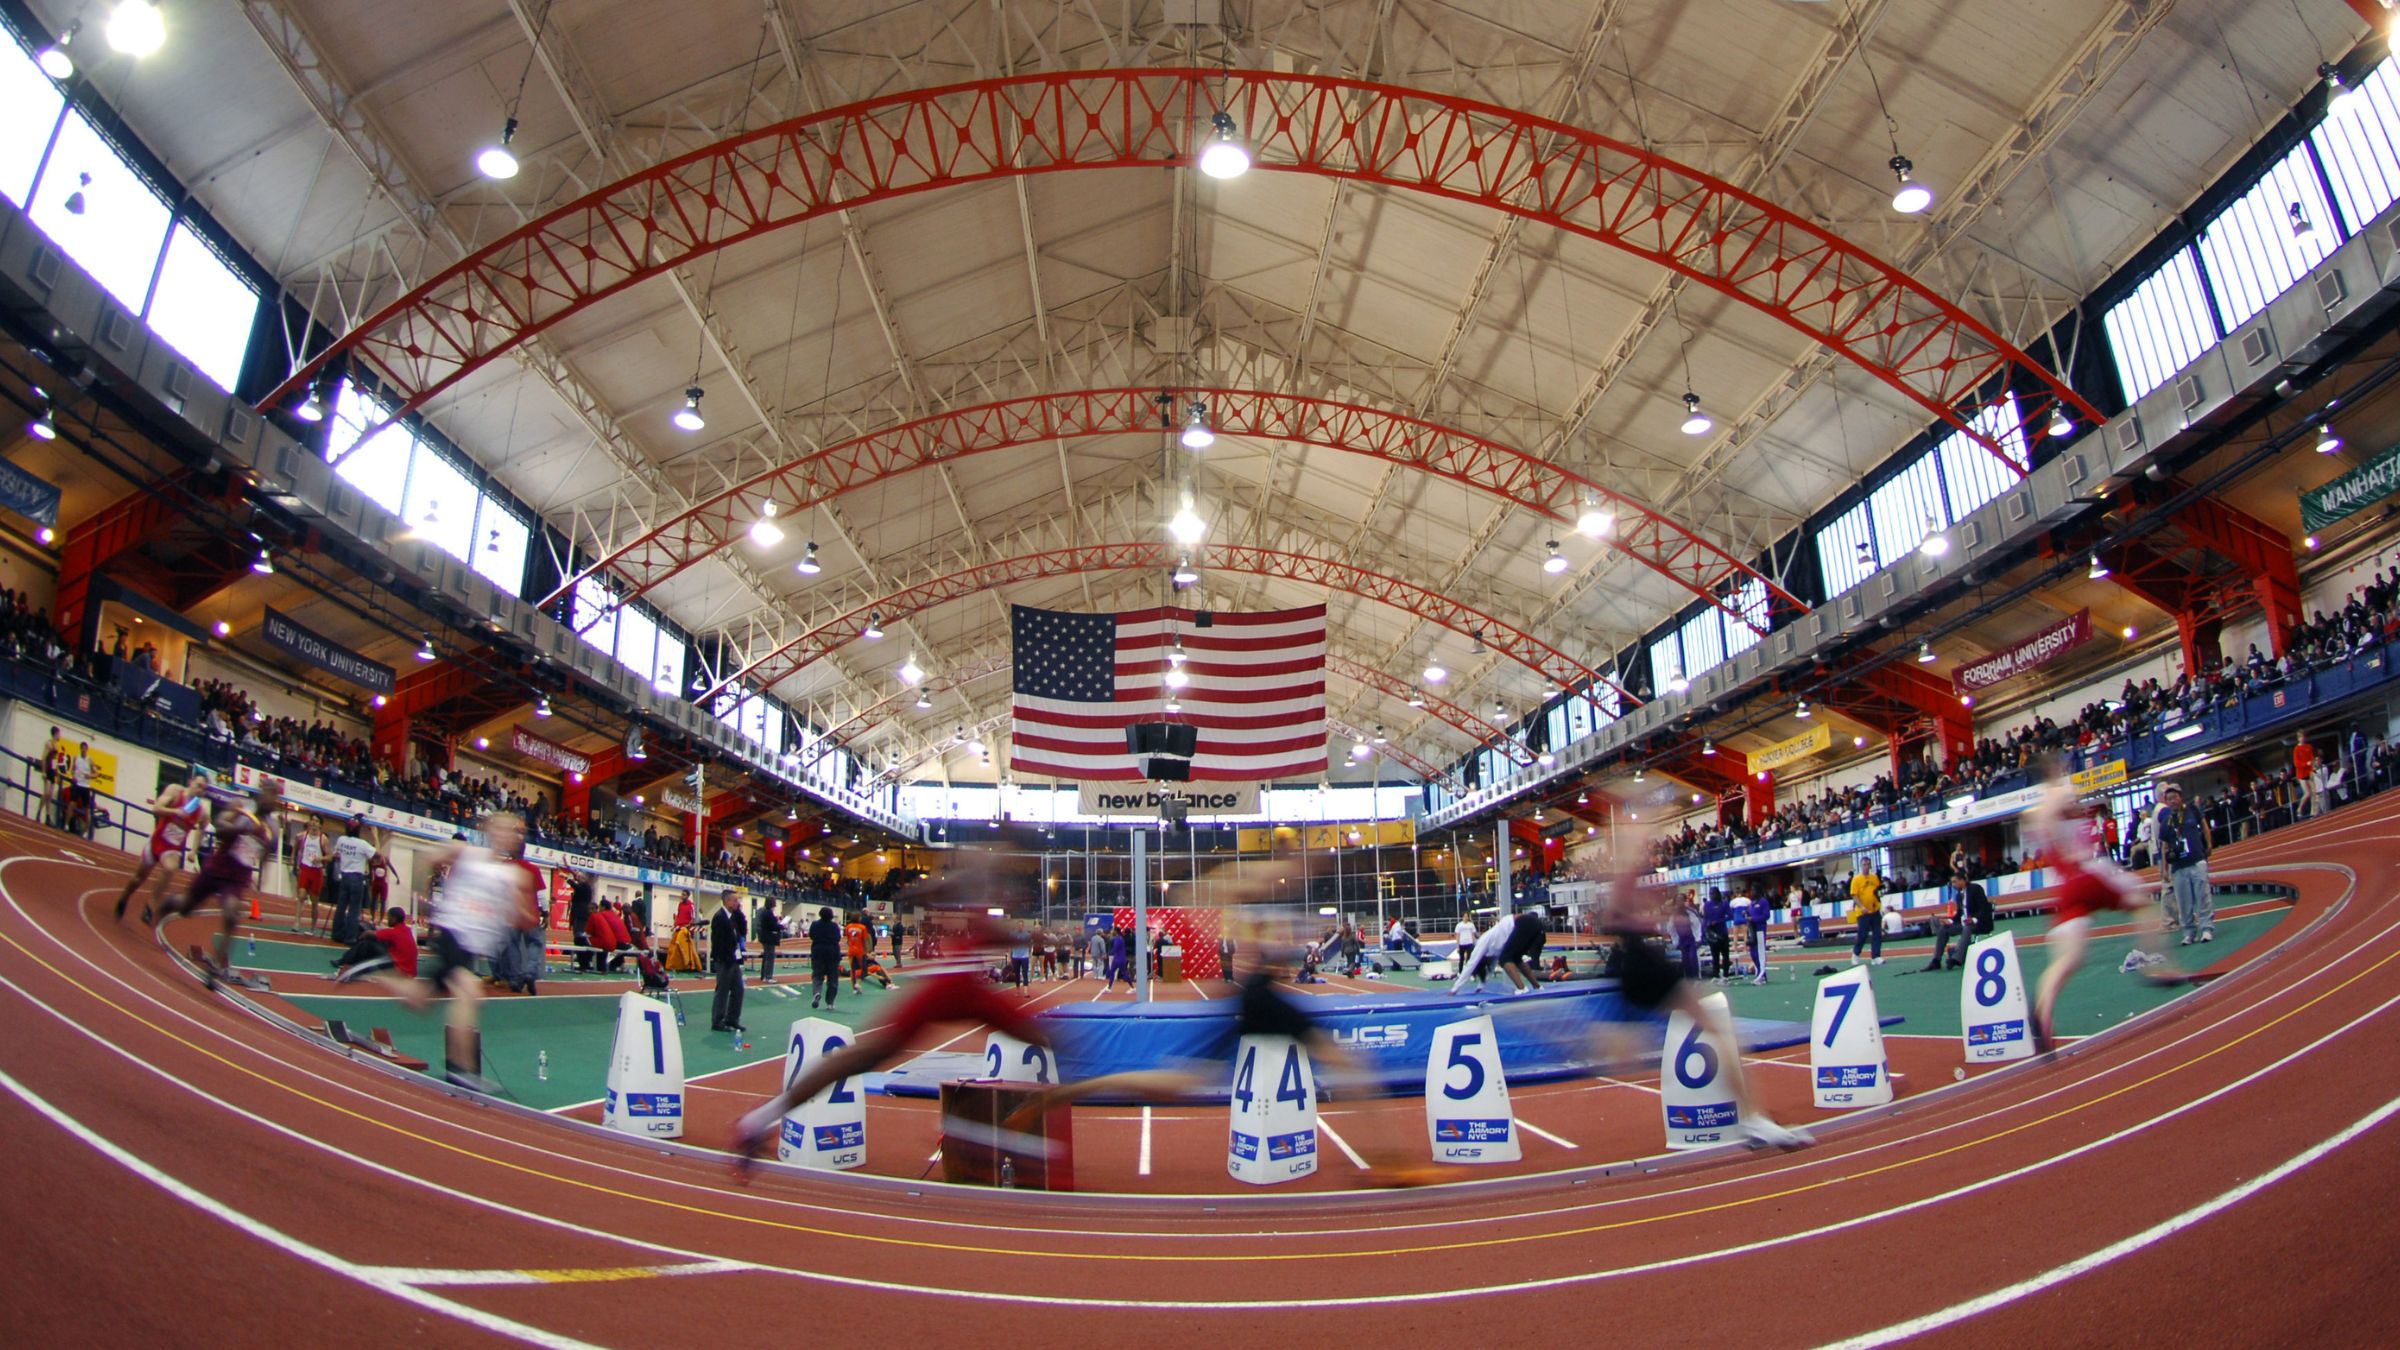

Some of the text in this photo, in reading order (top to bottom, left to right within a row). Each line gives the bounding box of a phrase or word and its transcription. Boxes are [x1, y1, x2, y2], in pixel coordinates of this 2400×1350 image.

[269, 618, 390, 687] NEW YORK UNIVERSITY
[1963, 622, 2076, 684] FORDHAM UNIVERSITY
[1099, 793, 1143, 808] new
[1975, 948, 2006, 1007] 8
[1823, 983, 1860, 1048] 7
[1333, 1024, 1408, 1044] UCS
[644, 1010, 664, 1074] 1
[1675, 1018, 1718, 1089] 6
[1977, 1048, 2005, 1057] UCS
[787, 1033, 855, 1104] 2 2
[1443, 1033, 1484, 1100] 5
[1235, 1044, 1306, 1113] 4 4
[1842, 1072, 1876, 1080] ARMORY
[1824, 1094, 1853, 1102] UCS
[1697, 1110, 1736, 1120] ARMORY
[648, 1123, 674, 1131] UCS
[1685, 1133, 1720, 1142] UCS
[780, 1147, 790, 1158] CS
[833, 1153, 857, 1163] UCS
[1446, 1148, 1482, 1157] UCS
[1230, 1162, 1240, 1171] CS
[1289, 1160, 1311, 1173] UCS
